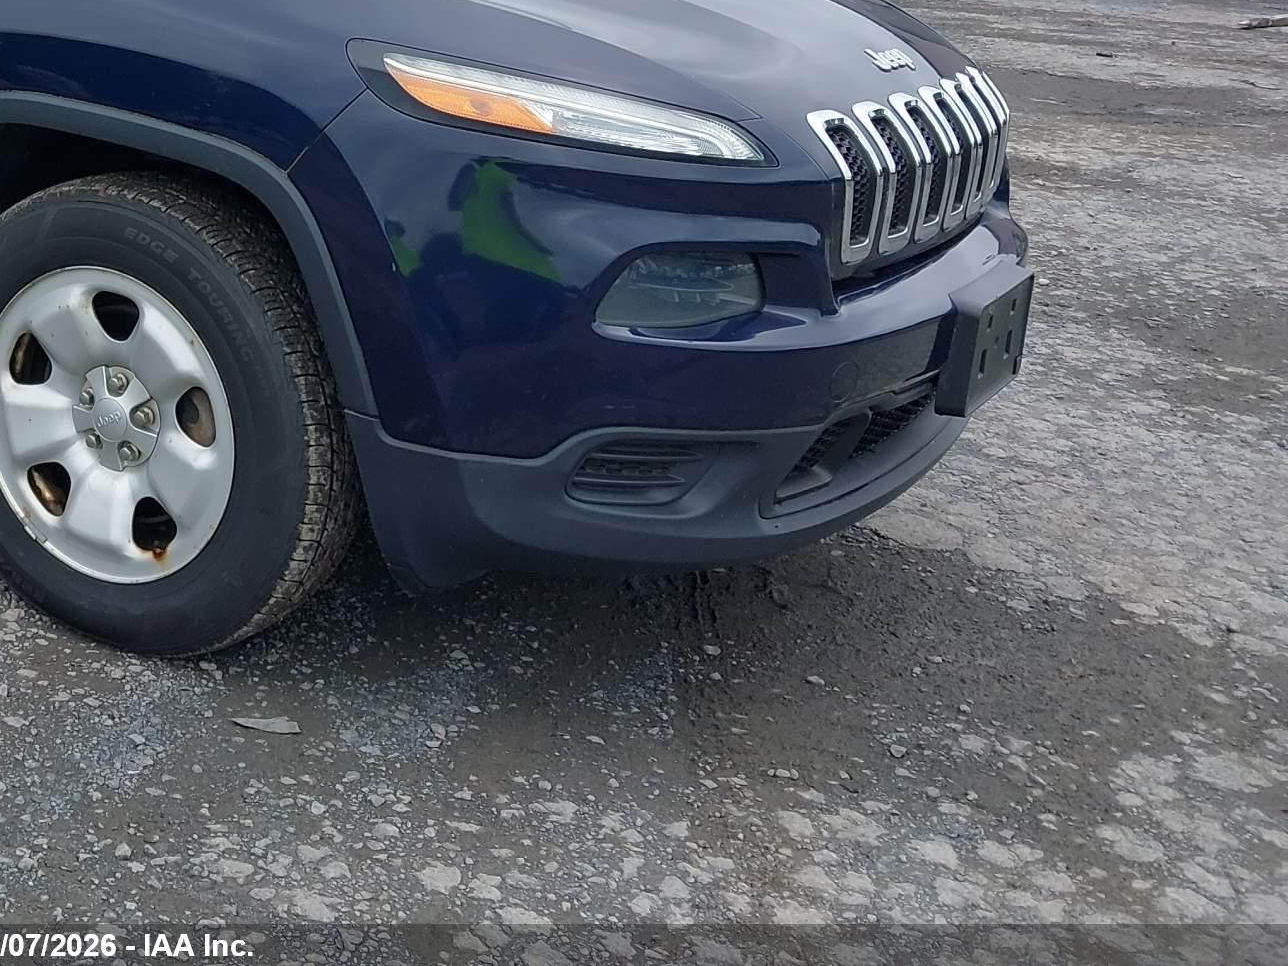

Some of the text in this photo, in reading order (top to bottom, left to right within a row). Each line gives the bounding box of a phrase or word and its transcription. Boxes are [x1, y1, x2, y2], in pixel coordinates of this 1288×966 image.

[863, 48, 916, 72] Jeep
[124, 227, 179, 263] EDGE
[97, 411, 121, 426] Jeep
